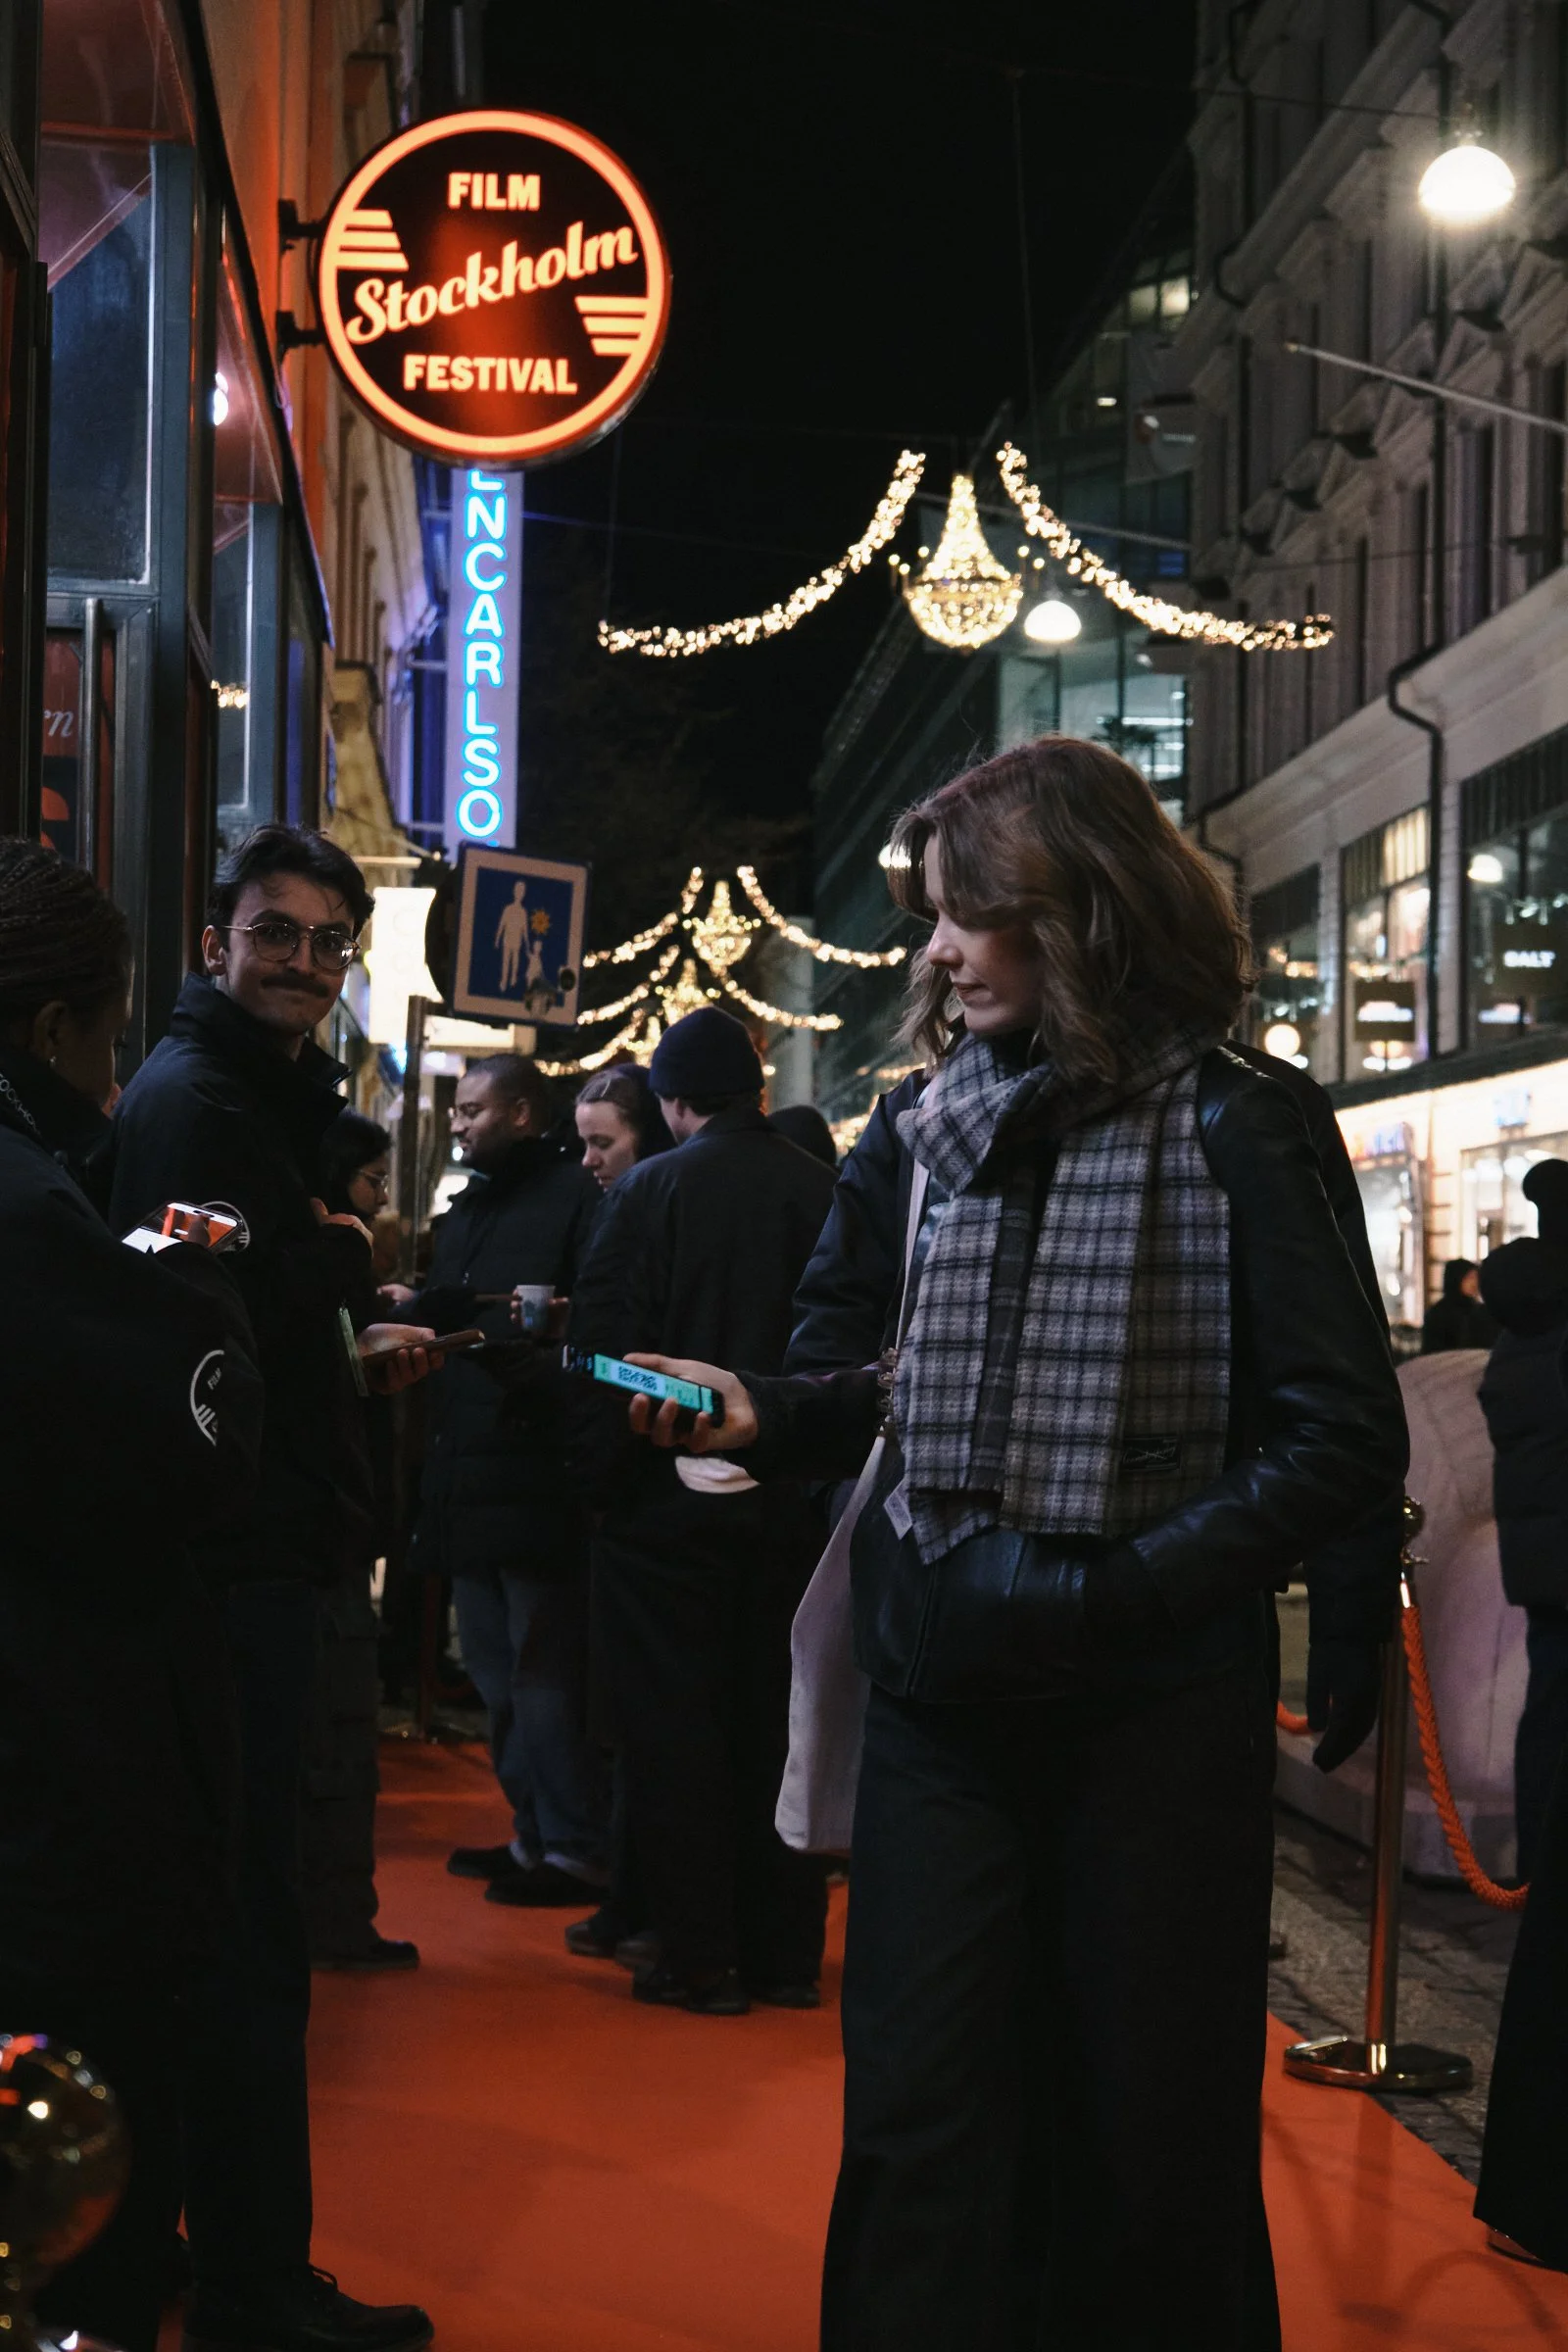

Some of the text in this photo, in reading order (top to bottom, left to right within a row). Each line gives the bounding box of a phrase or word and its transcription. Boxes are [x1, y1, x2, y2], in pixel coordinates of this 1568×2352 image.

[448, 172, 541, 211] FILM
[345, 220, 638, 344] Stockholm
[403, 355, 578, 395] FESTIVAL
